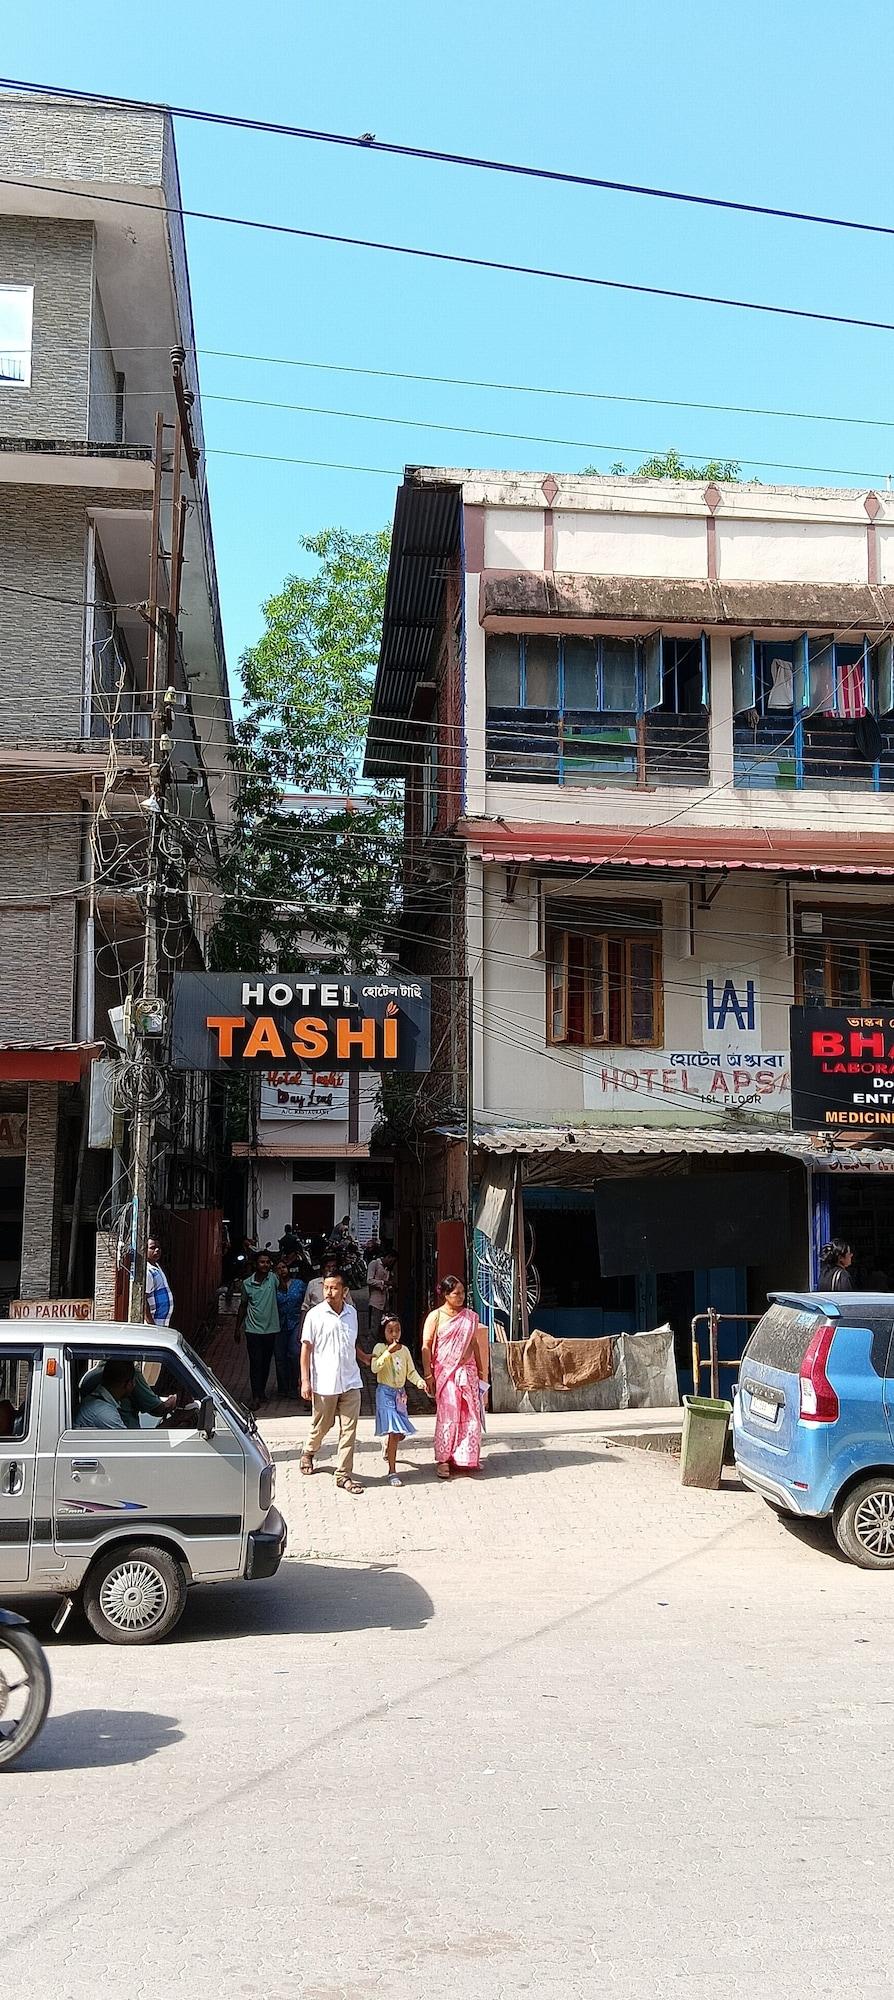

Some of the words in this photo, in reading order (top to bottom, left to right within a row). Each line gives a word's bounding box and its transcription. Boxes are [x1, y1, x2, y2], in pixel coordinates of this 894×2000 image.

[242, 983, 359, 1007] HOTEL
[206, 1016, 398, 1059] TASHI
[812, 1031, 894, 1057] BH
[601, 1068, 699, 1094] HOTEL
[724, 1095, 762, 1104] FLOOR
[825, 1111, 894, 1124] MEDICIN
[14, 1304, 30, 1318] NO
[35, 1304, 89, 1318] PARKING
